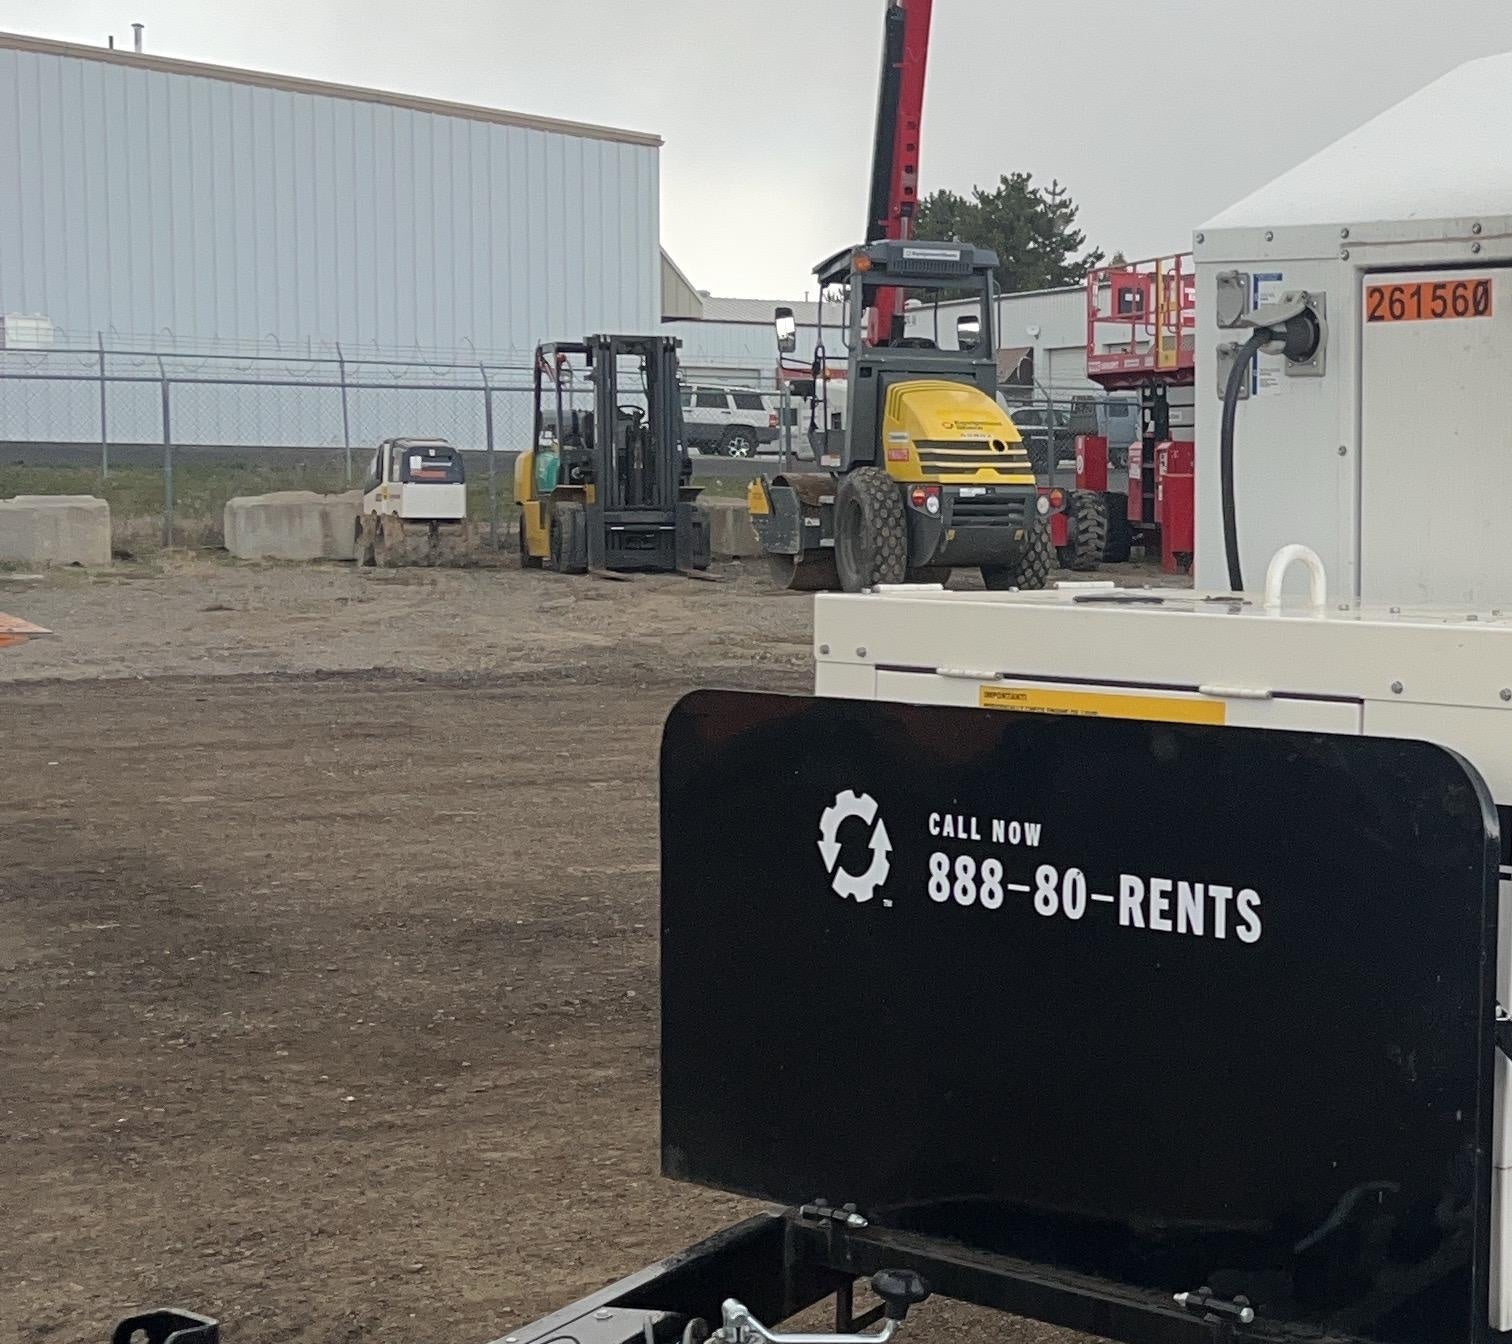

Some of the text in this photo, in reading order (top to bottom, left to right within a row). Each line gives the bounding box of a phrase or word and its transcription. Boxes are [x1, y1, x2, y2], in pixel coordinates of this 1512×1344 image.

[1366, 279, 1490, 323] 261560
[928, 812, 1043, 848] CALL NOW
[927, 850, 1263, 944] 888-80-RENTS
